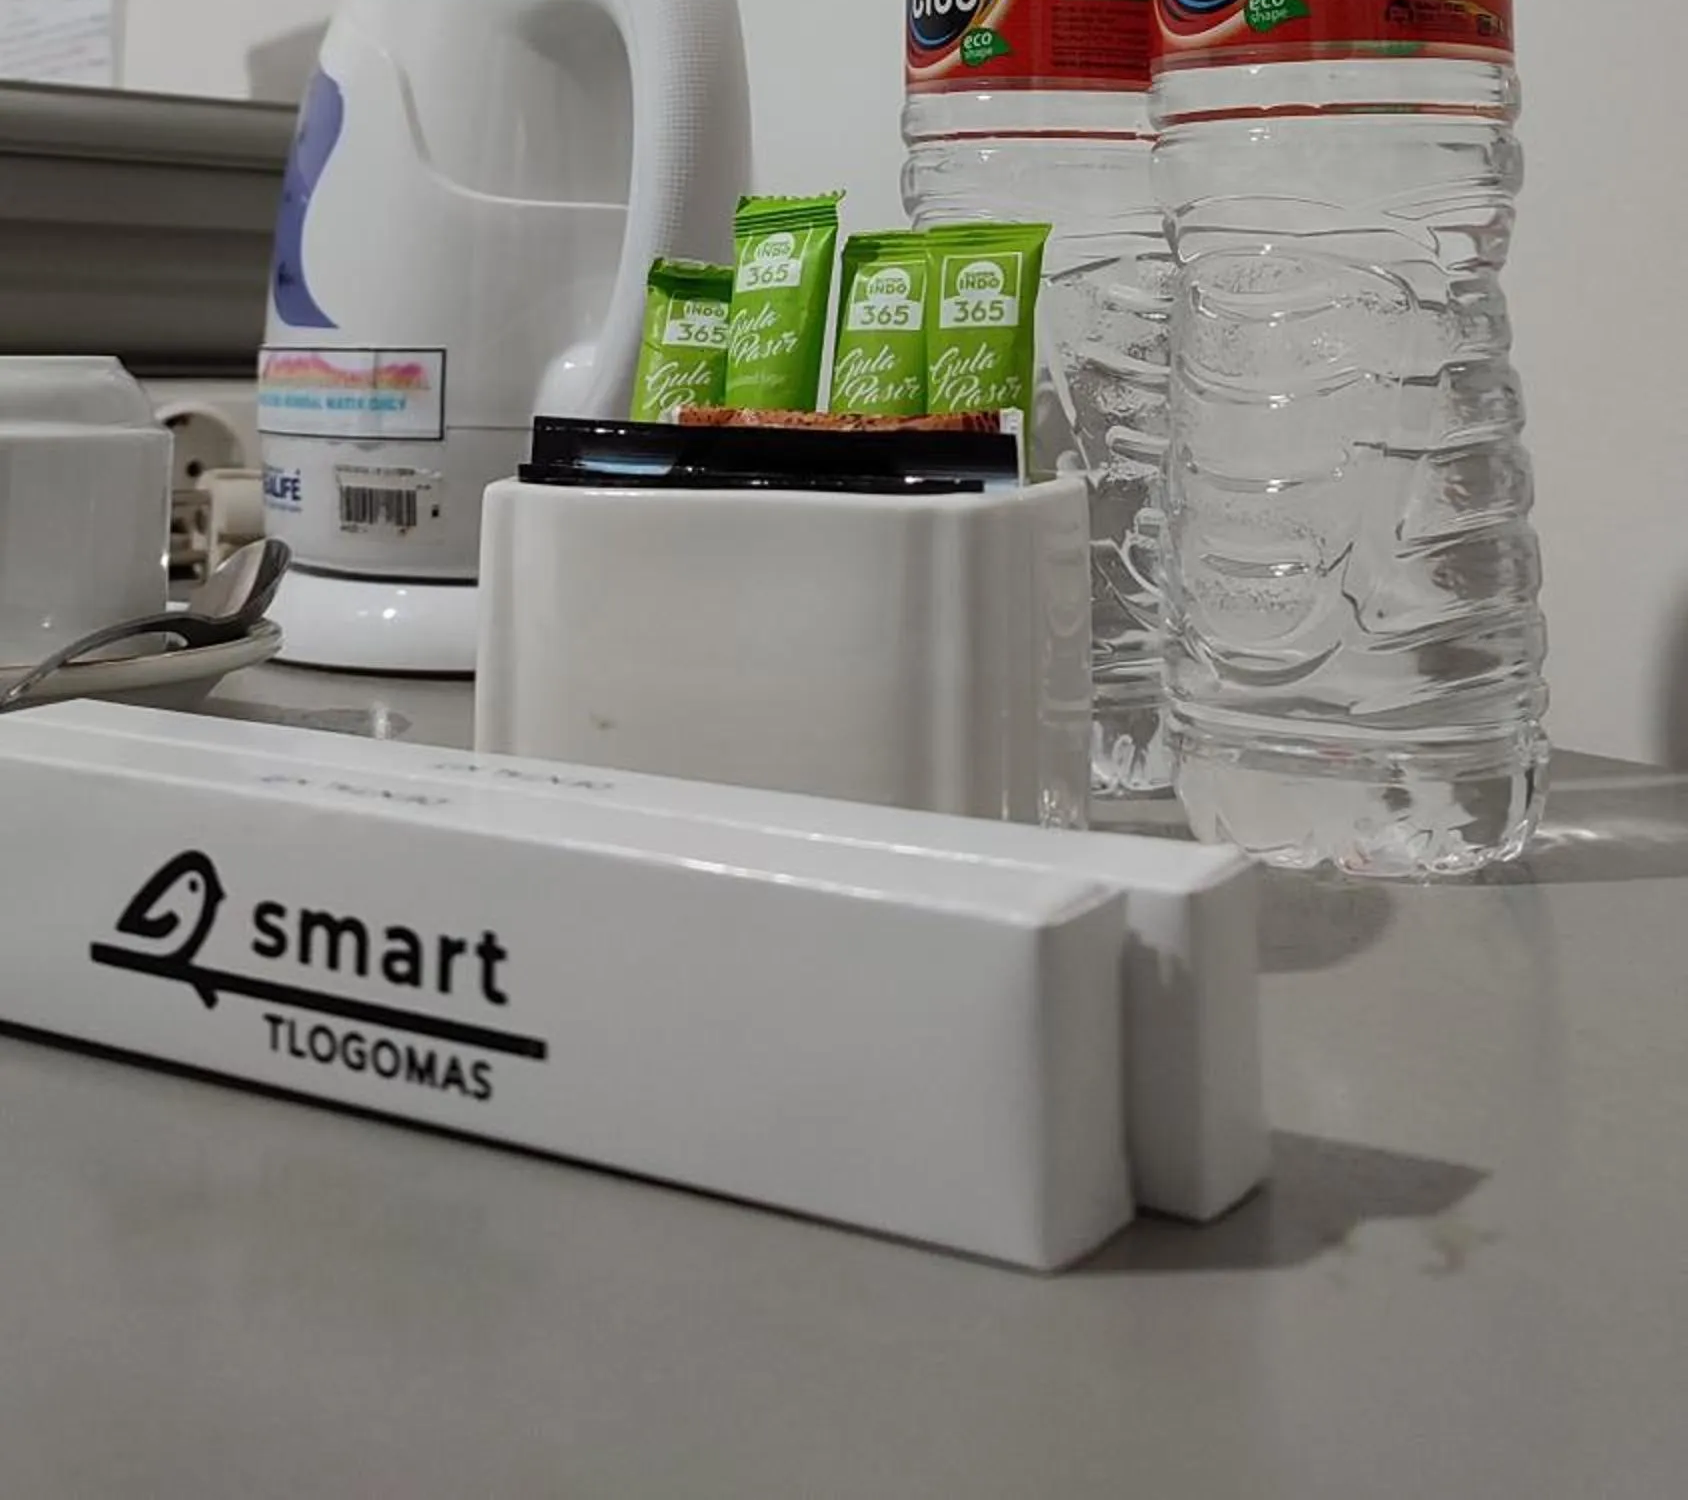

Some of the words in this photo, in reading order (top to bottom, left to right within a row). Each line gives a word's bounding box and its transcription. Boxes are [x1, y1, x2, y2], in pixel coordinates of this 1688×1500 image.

[1251, 8, 1289, 23] shape
[963, 32, 993, 49] eco
[746, 263, 790, 287] 365
[729, 301, 778, 357] Gula
[860, 304, 911, 327] 365
[952, 299, 1006, 323] 365
[676, 322, 729, 345] 365
[732, 330, 799, 369] Pasir
[644, 361, 713, 410] Gula
[833, 344, 896, 401] Gula
[929, 342, 999, 405] Gula
[844, 374, 921, 409] Pasir
[944, 374, 1023, 411] Pasir
[252, 900, 509, 1005] smart
[262, 1013, 494, 1102] TLOGOMAS
